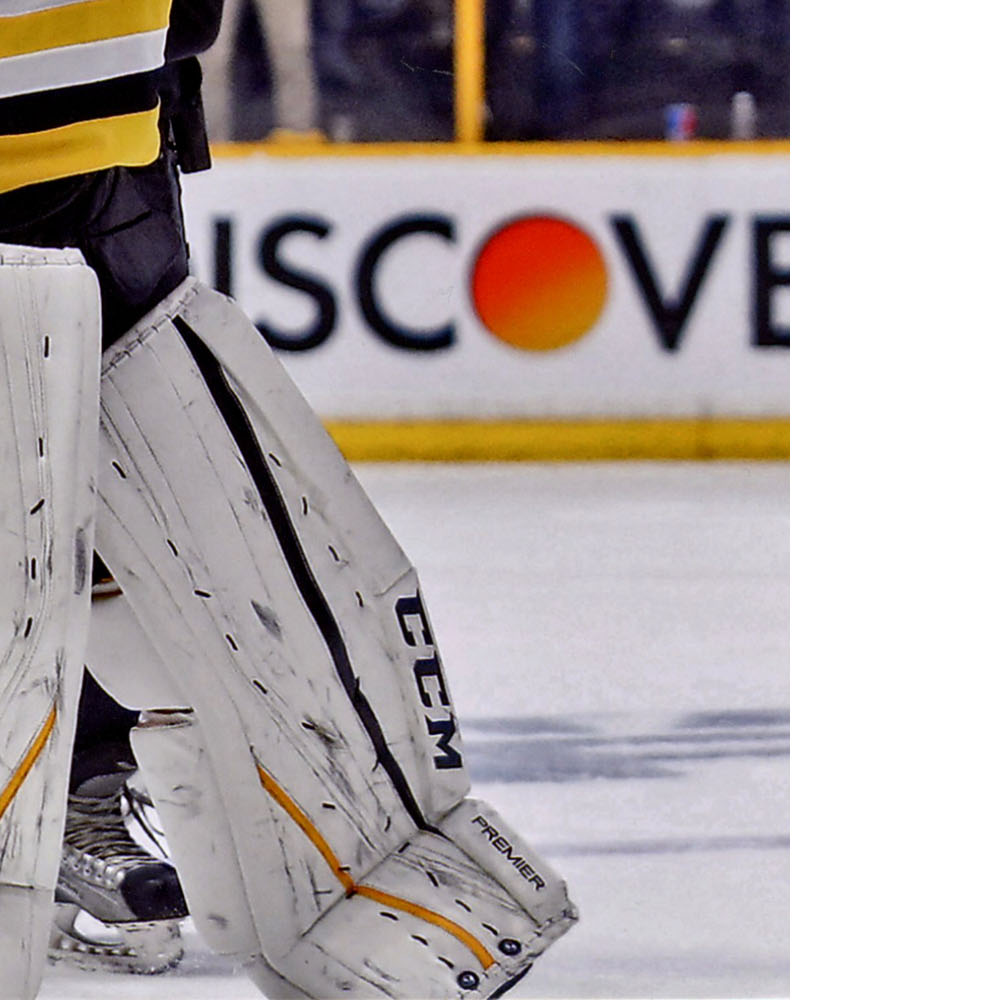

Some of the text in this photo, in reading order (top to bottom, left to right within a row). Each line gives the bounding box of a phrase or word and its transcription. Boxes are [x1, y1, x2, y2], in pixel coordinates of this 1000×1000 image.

[208, 211, 790, 353] ISCOVE
[394, 587, 463, 770] CCM
[472, 815, 546, 892] PREMIER
